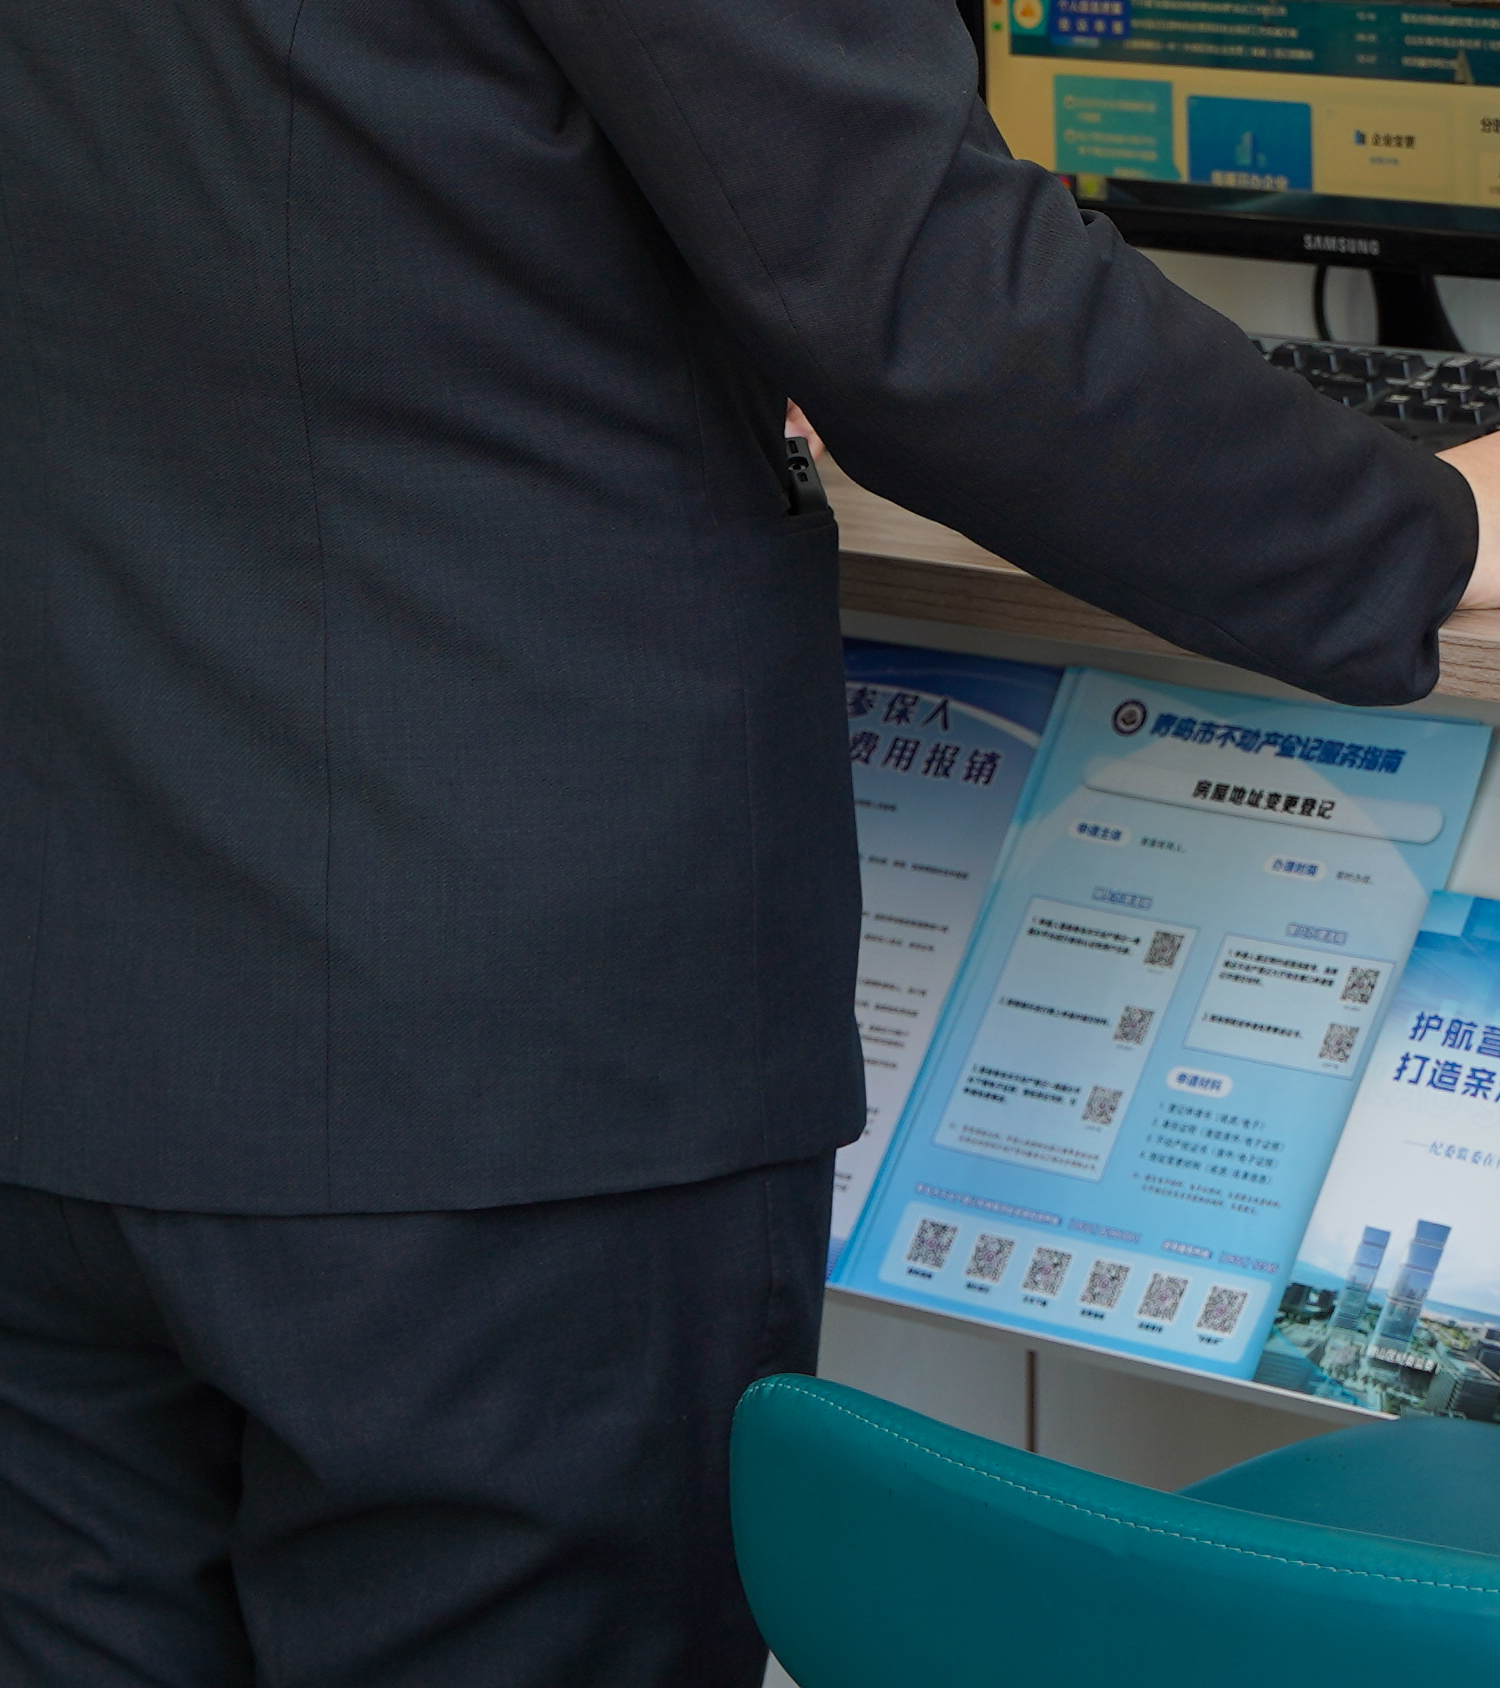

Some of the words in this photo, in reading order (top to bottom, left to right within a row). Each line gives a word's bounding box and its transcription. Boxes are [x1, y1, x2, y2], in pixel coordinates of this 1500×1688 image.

[1303, 233, 1381, 256] SAMSUNG
[1150, 712, 1407, 774] 青岛市不动产登记服务指南
[1192, 779, 1336, 820] 房屋地址变更登记
